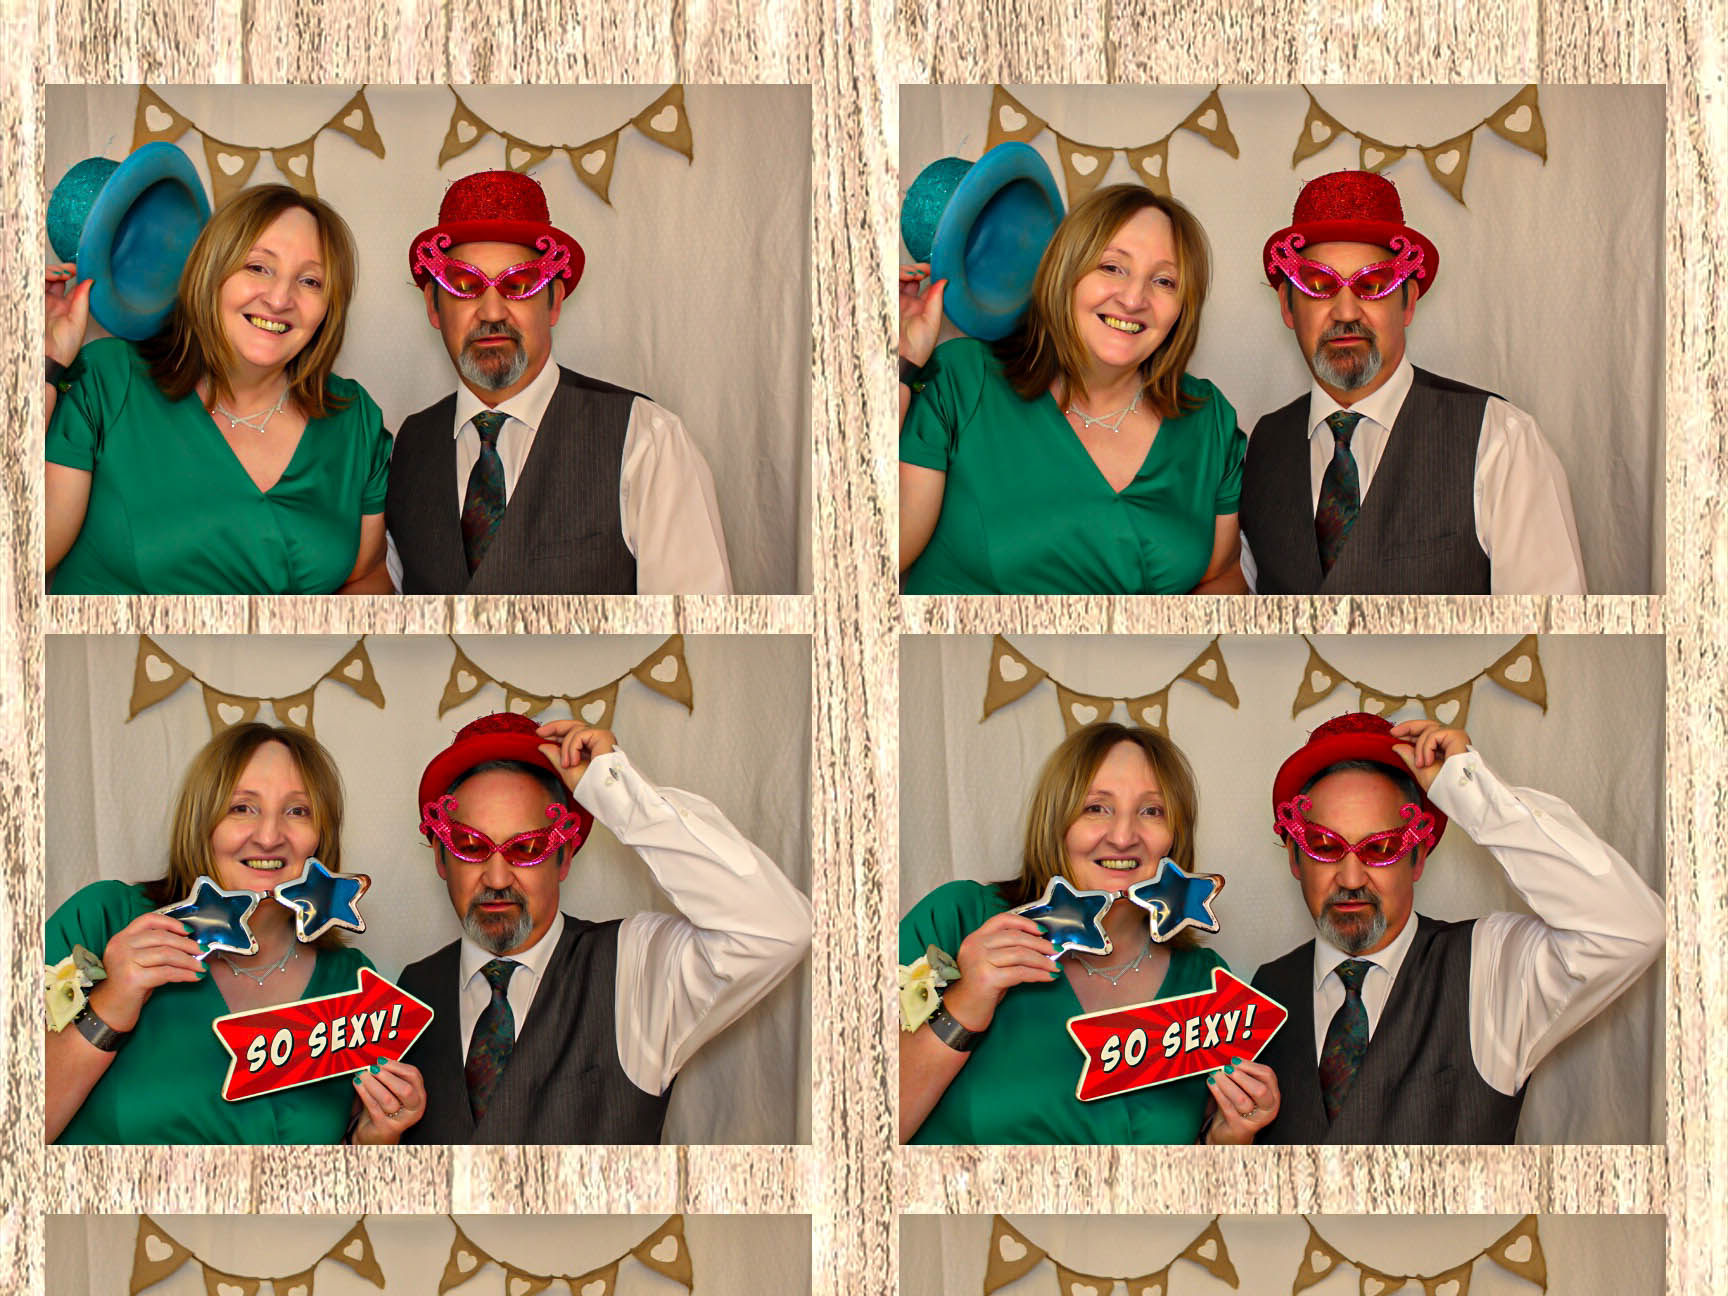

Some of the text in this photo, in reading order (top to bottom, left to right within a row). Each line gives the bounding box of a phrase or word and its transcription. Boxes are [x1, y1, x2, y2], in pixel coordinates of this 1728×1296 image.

[247, 1004, 403, 1073] SO SEXY!
[1101, 1004, 1257, 1073] SO SEXY!
